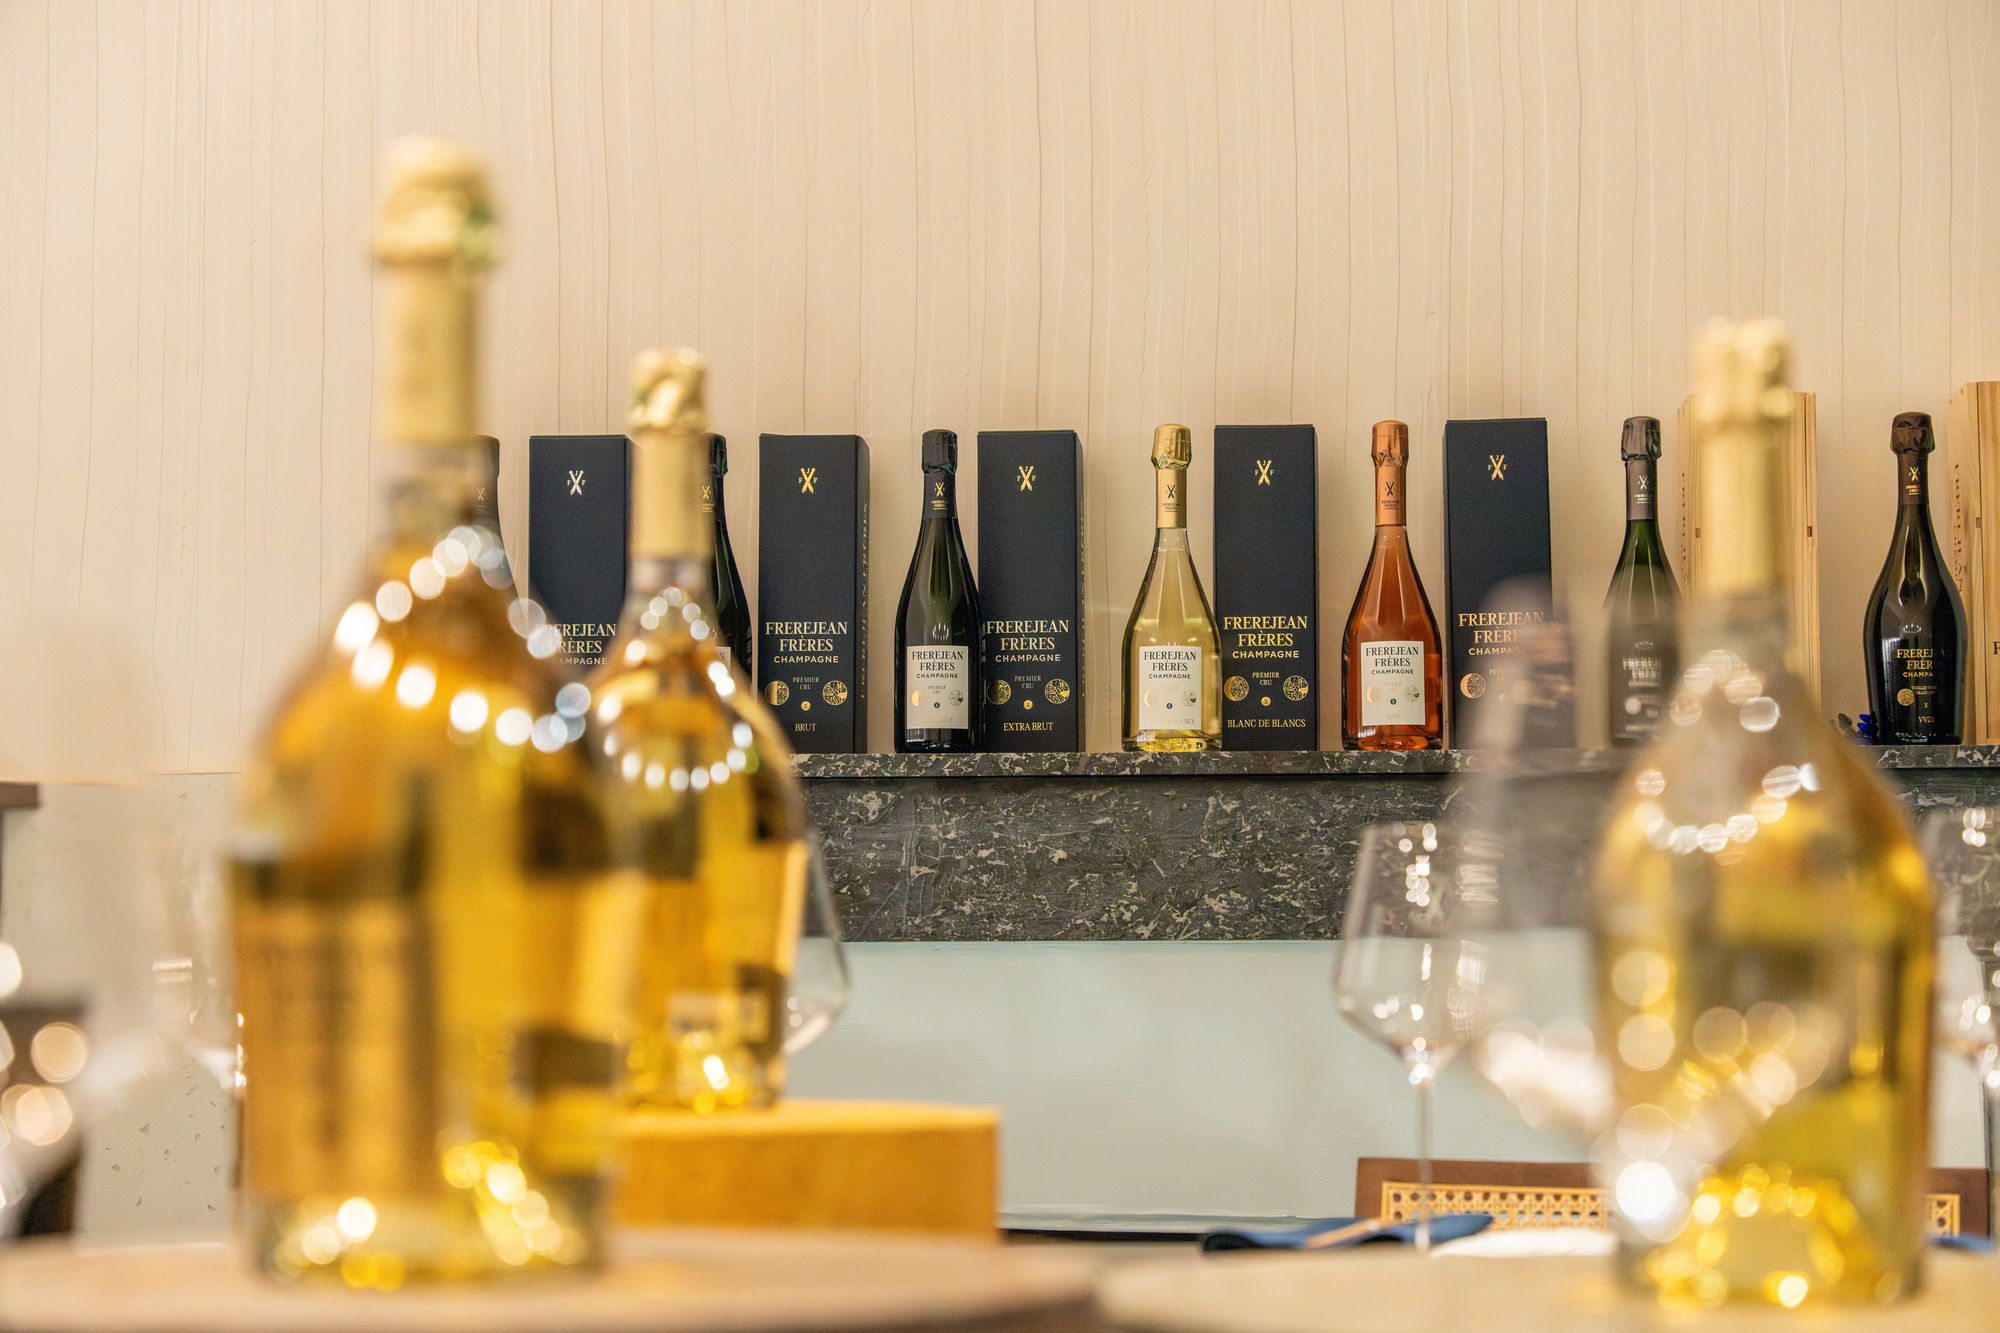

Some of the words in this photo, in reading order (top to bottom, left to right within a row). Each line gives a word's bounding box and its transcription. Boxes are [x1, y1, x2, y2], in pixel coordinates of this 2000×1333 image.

[1223, 616, 1308, 630] FREREJEAN
[1458, 612, 1544, 627] FREREJEAN
[550, 624, 616, 636] EREJEAN
[765, 622, 848, 634] FREREJEAN
[986, 620, 1070, 634] FREREJEAN
[1238, 630, 1294, 647] FRÈRES
[1474, 626, 1519, 644] FRÈR
[558, 637, 602, 654] RÈRES
[780, 636, 834, 652] FRÈRES
[1000, 634, 1055, 650] FRÈRES
[912, 650, 964, 660] FREREJEAN
[1144, 651, 1197, 660] FREREJEAN
[1232, 650, 1300, 658] CHAMPAGNE
[1366, 646, 1419, 656] FREREJEAN
[774, 656, 839, 664] CHAMPAGNE
[995, 654, 1060, 662] CHAMPAGNE
[1374, 656, 1411, 667] FRÈRES
[1906, 658, 1933, 670] FRÈR
[920, 660, 955, 670] FRÈRES
[1152, 660, 1188, 672] FRÈRES
[795, 723, 816, 732] BRUT
[1003, 722, 1030, 731] EXTRA
[1032, 722, 1054, 731] BRUT
[1227, 719, 1257, 728] BLANC
[1258, 719, 1270, 728] DE
[1272, 718, 1306, 728] BLANCS
